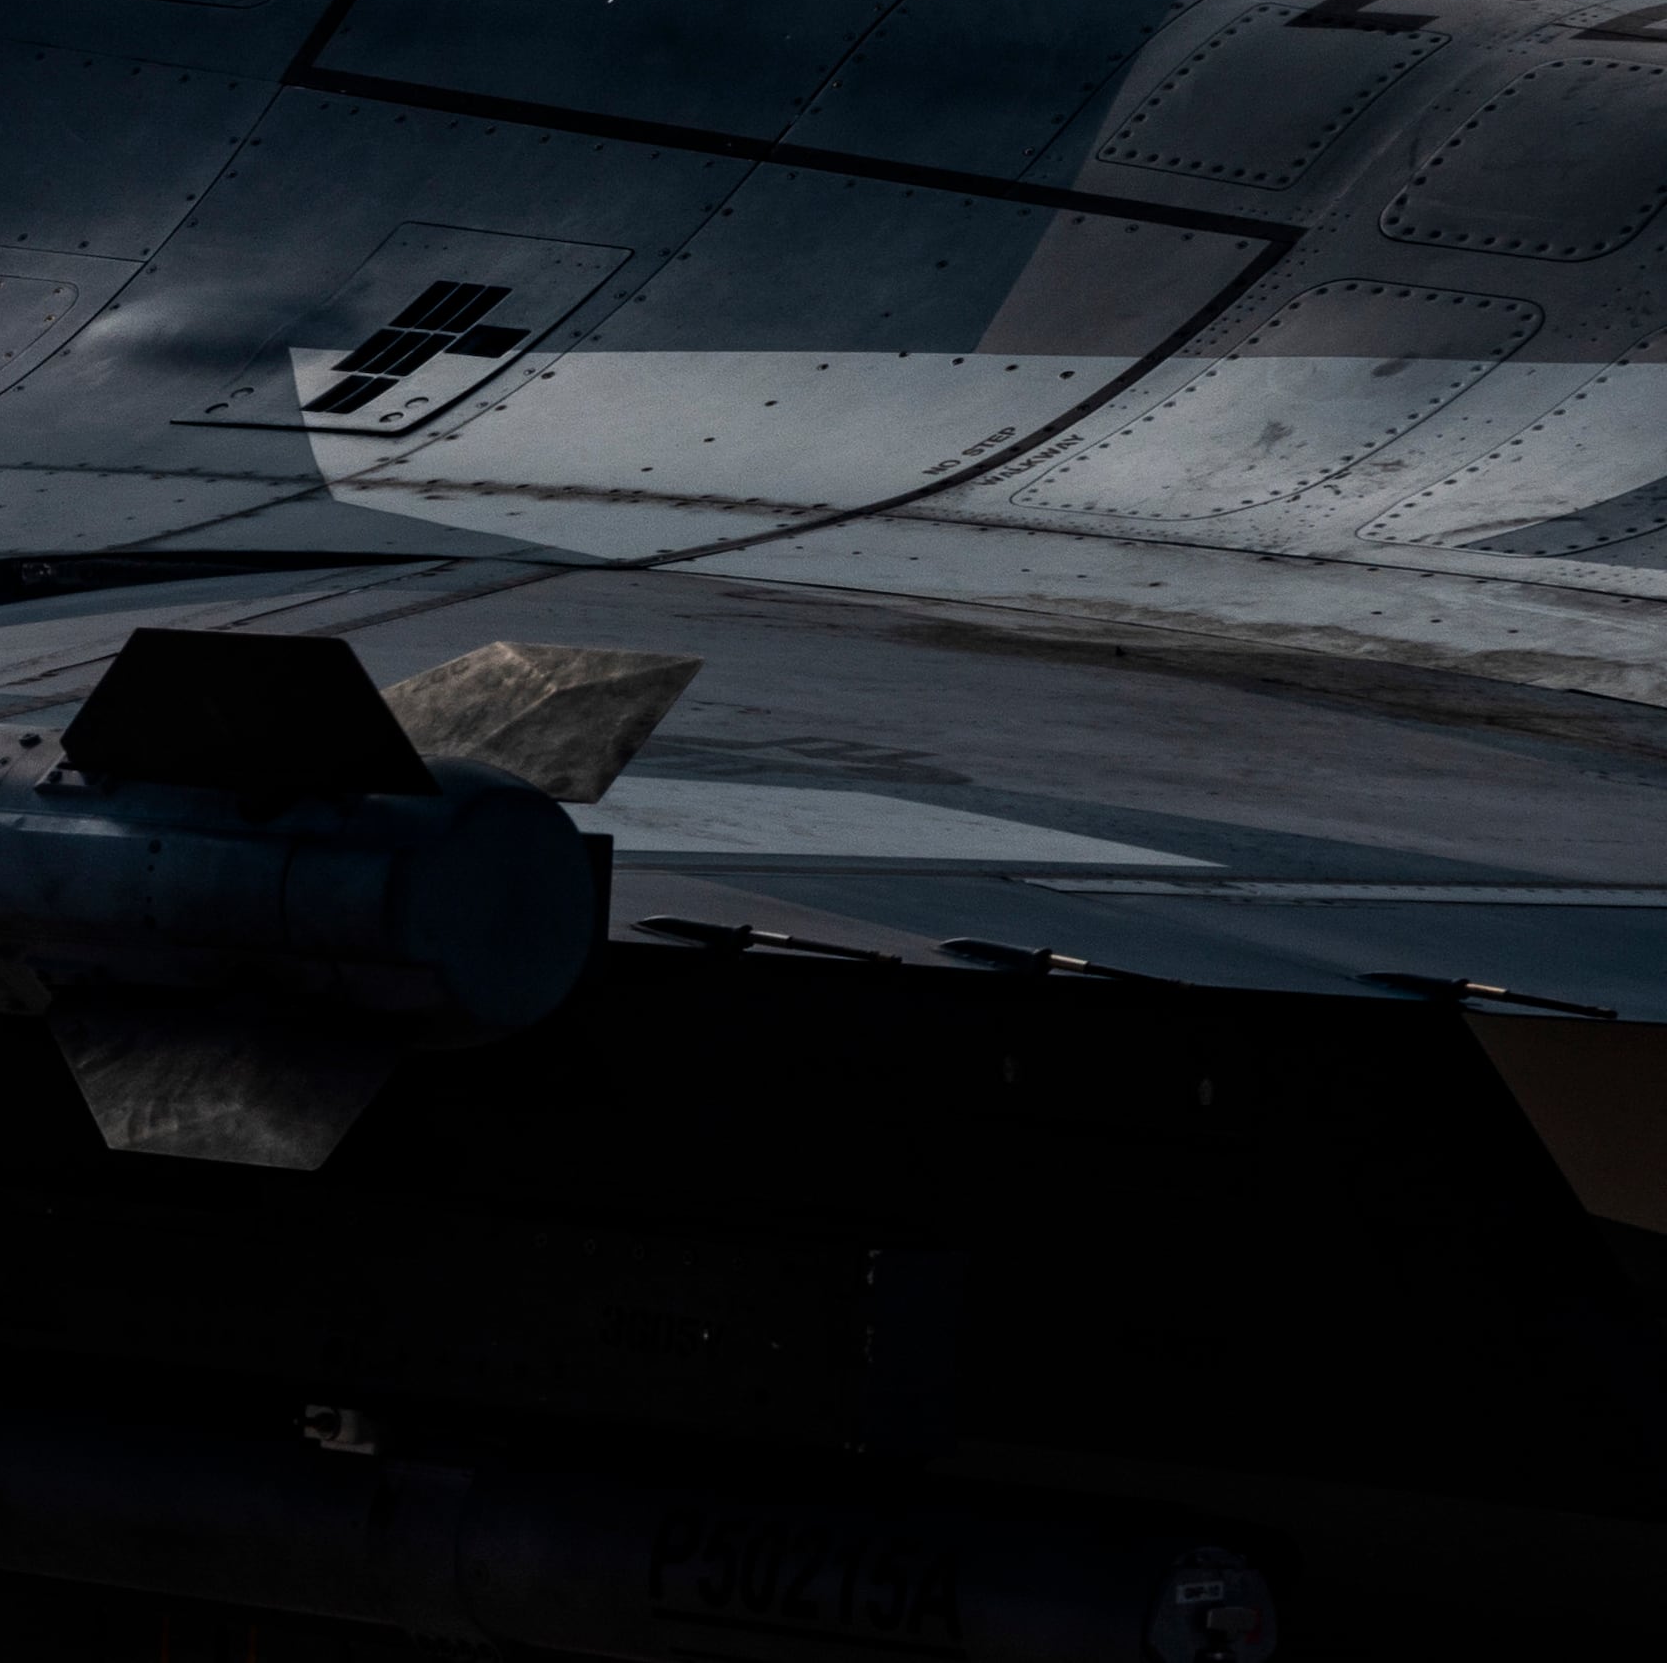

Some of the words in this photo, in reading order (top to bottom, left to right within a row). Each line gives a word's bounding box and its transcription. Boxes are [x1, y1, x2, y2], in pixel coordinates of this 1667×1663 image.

[922, 458, 962, 476] NO
[961, 426, 1017, 457] STEP
[973, 433, 1085, 486] WALKWAY
[648, 1508, 964, 1641] P50215A
